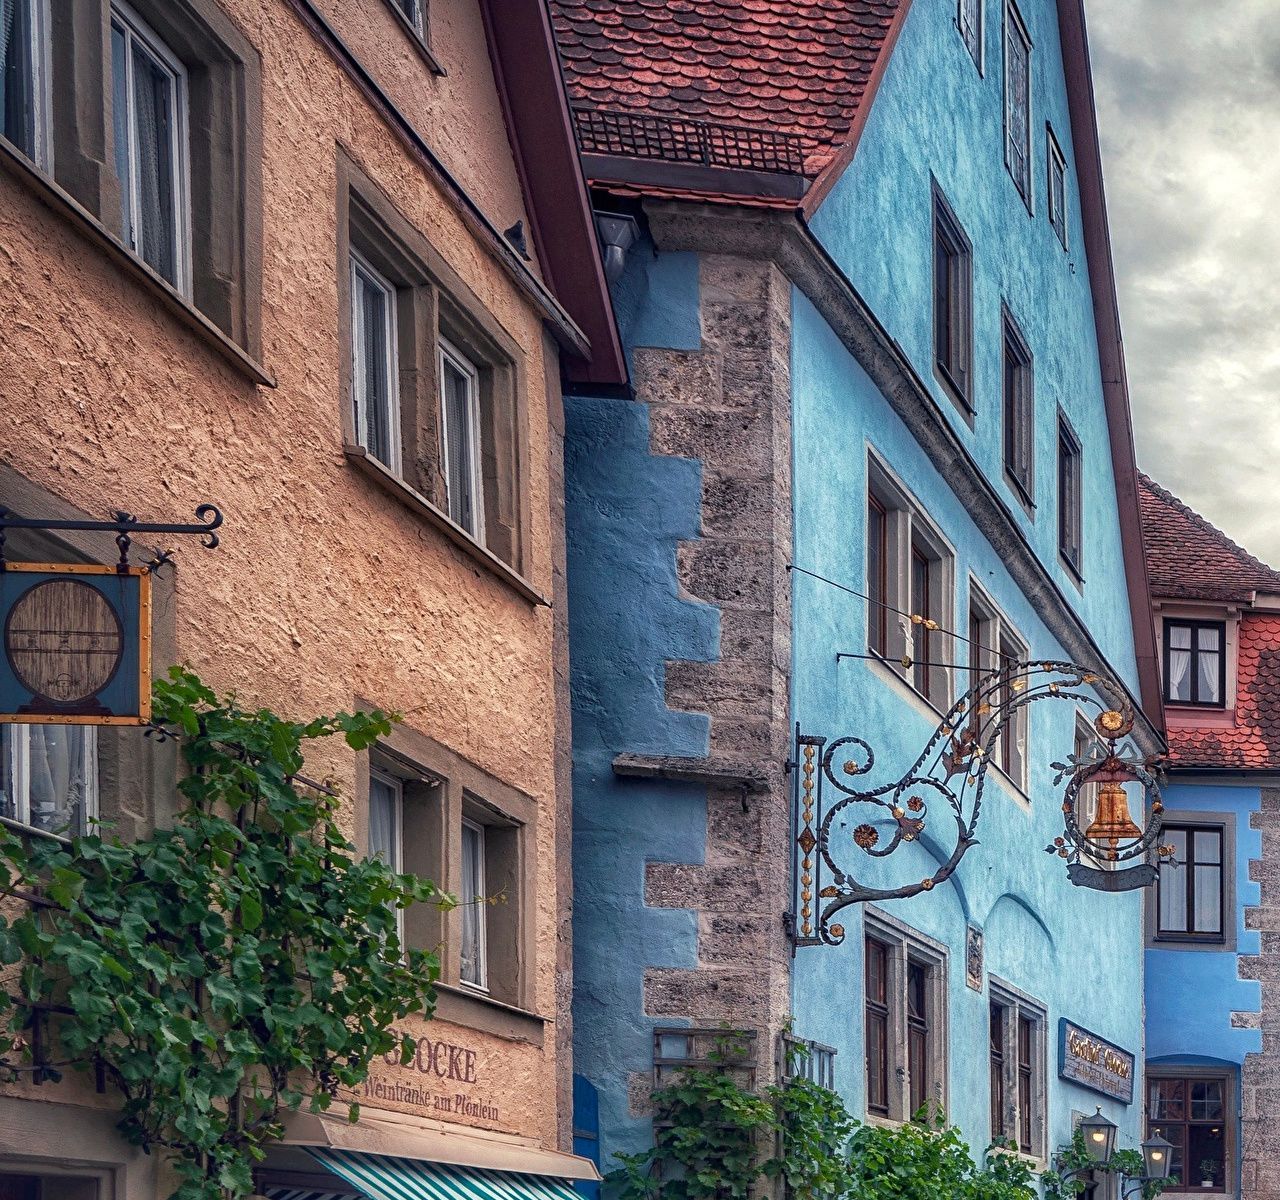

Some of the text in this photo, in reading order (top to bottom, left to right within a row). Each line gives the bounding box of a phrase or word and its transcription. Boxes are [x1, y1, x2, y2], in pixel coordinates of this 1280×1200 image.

[364, 1075, 499, 1121] Weintränke am Plönlein
